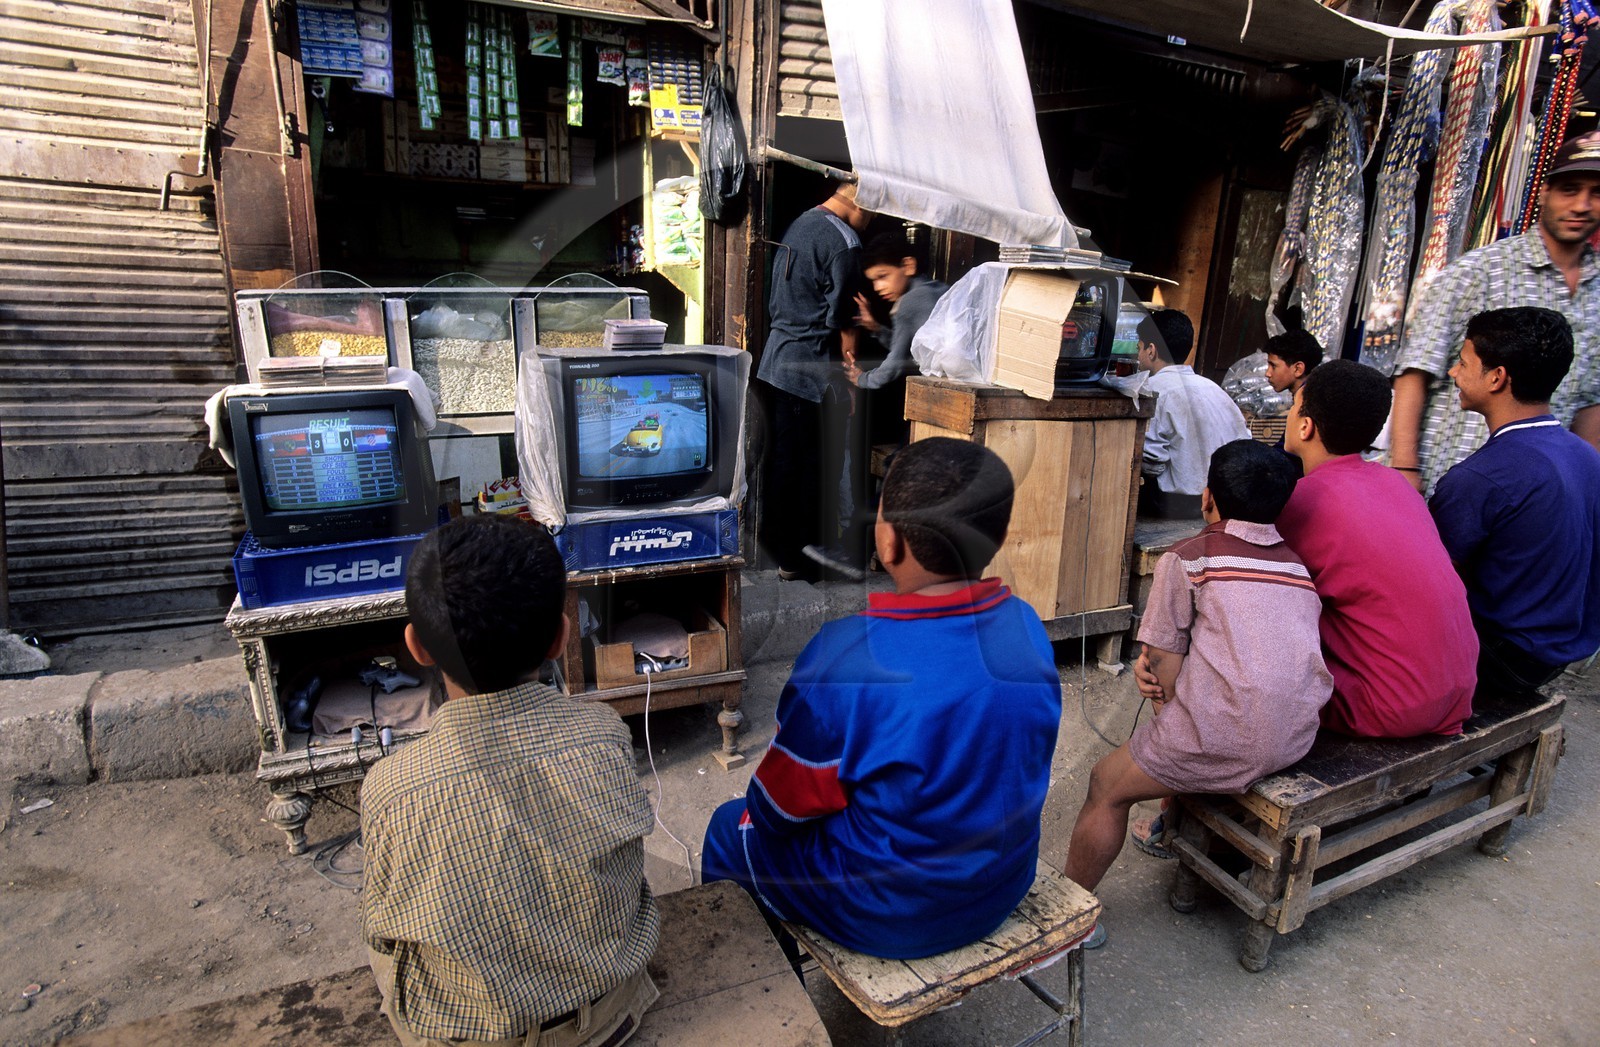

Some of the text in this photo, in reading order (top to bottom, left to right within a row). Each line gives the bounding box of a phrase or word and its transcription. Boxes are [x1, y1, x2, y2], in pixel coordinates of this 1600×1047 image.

[309, 417, 350, 431] RESULT
[314, 438, 349, 448] 3 0
[305, 555, 402, 587] PEPSI
